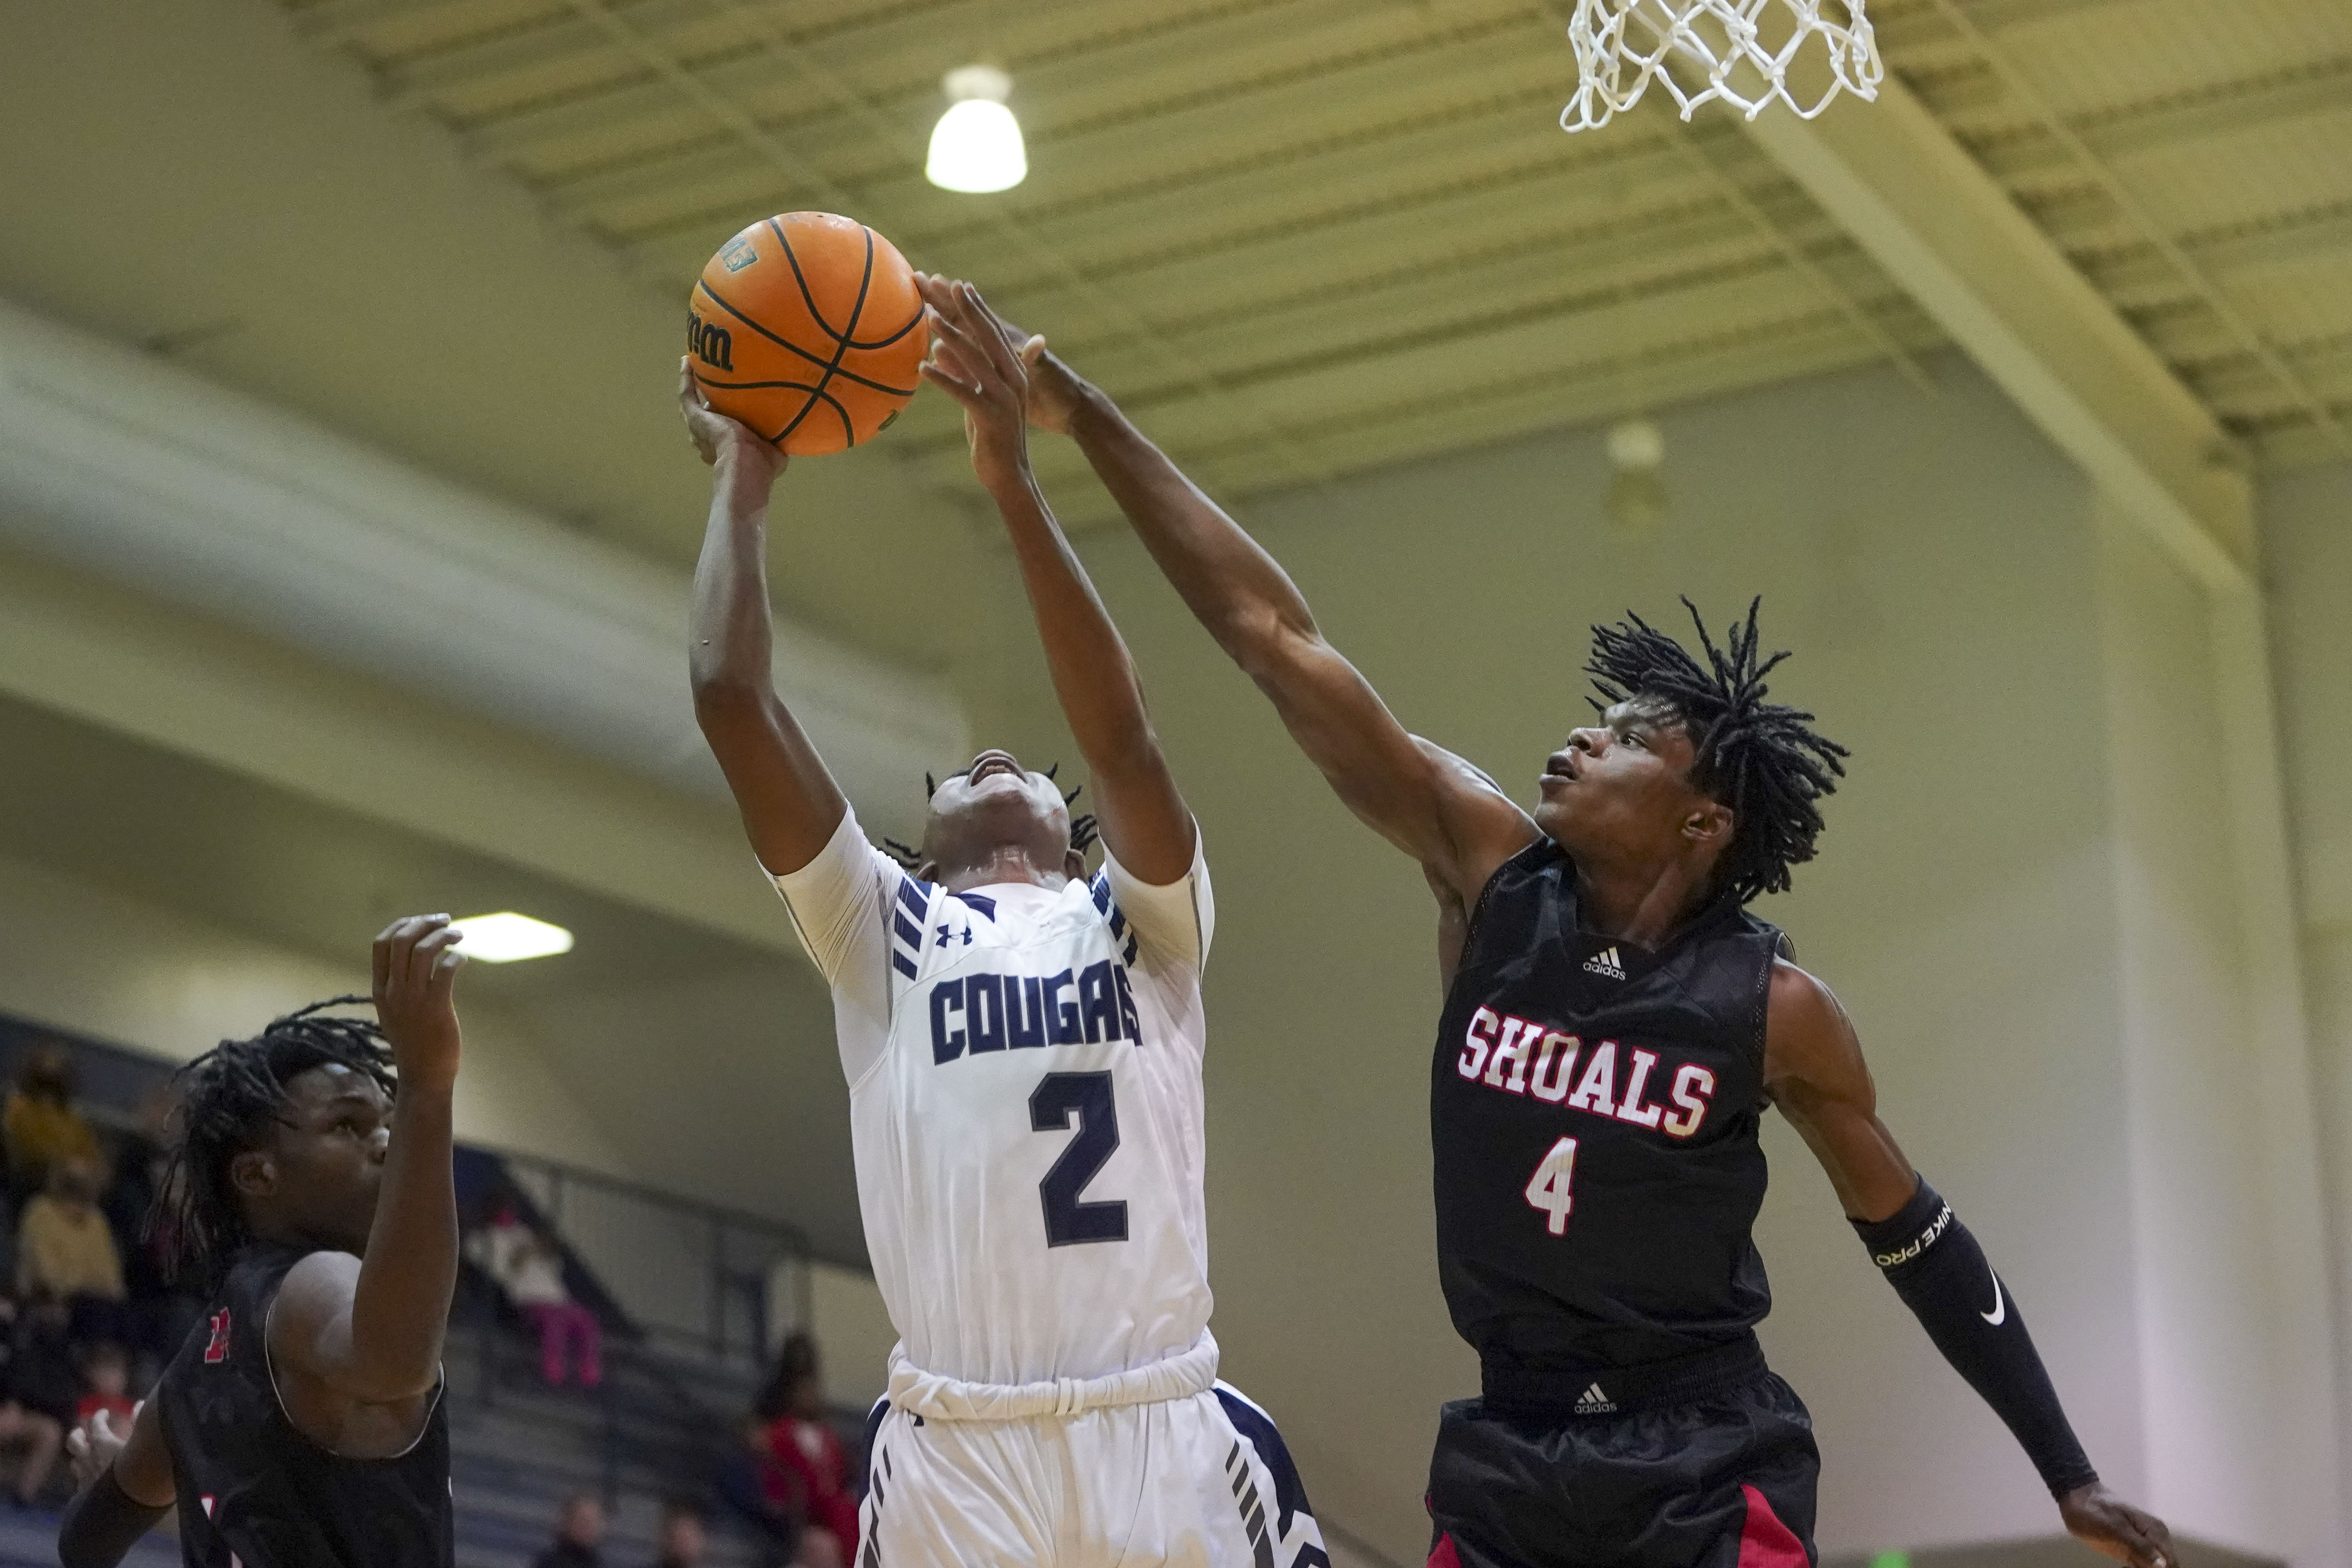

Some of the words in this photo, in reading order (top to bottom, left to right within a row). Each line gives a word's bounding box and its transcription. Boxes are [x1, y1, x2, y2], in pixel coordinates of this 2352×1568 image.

[1583, 961, 1627, 981] adidas
[1457, 1003, 1717, 1139] SHOALS
[1028, 1070, 1129, 1249] 2
[1523, 1134, 1580, 1237] 4
[1921, 1200, 1952, 1248] NIKE
[1877, 1238, 1921, 1266] PRO
[1574, 1402, 1618, 1414] adidas
